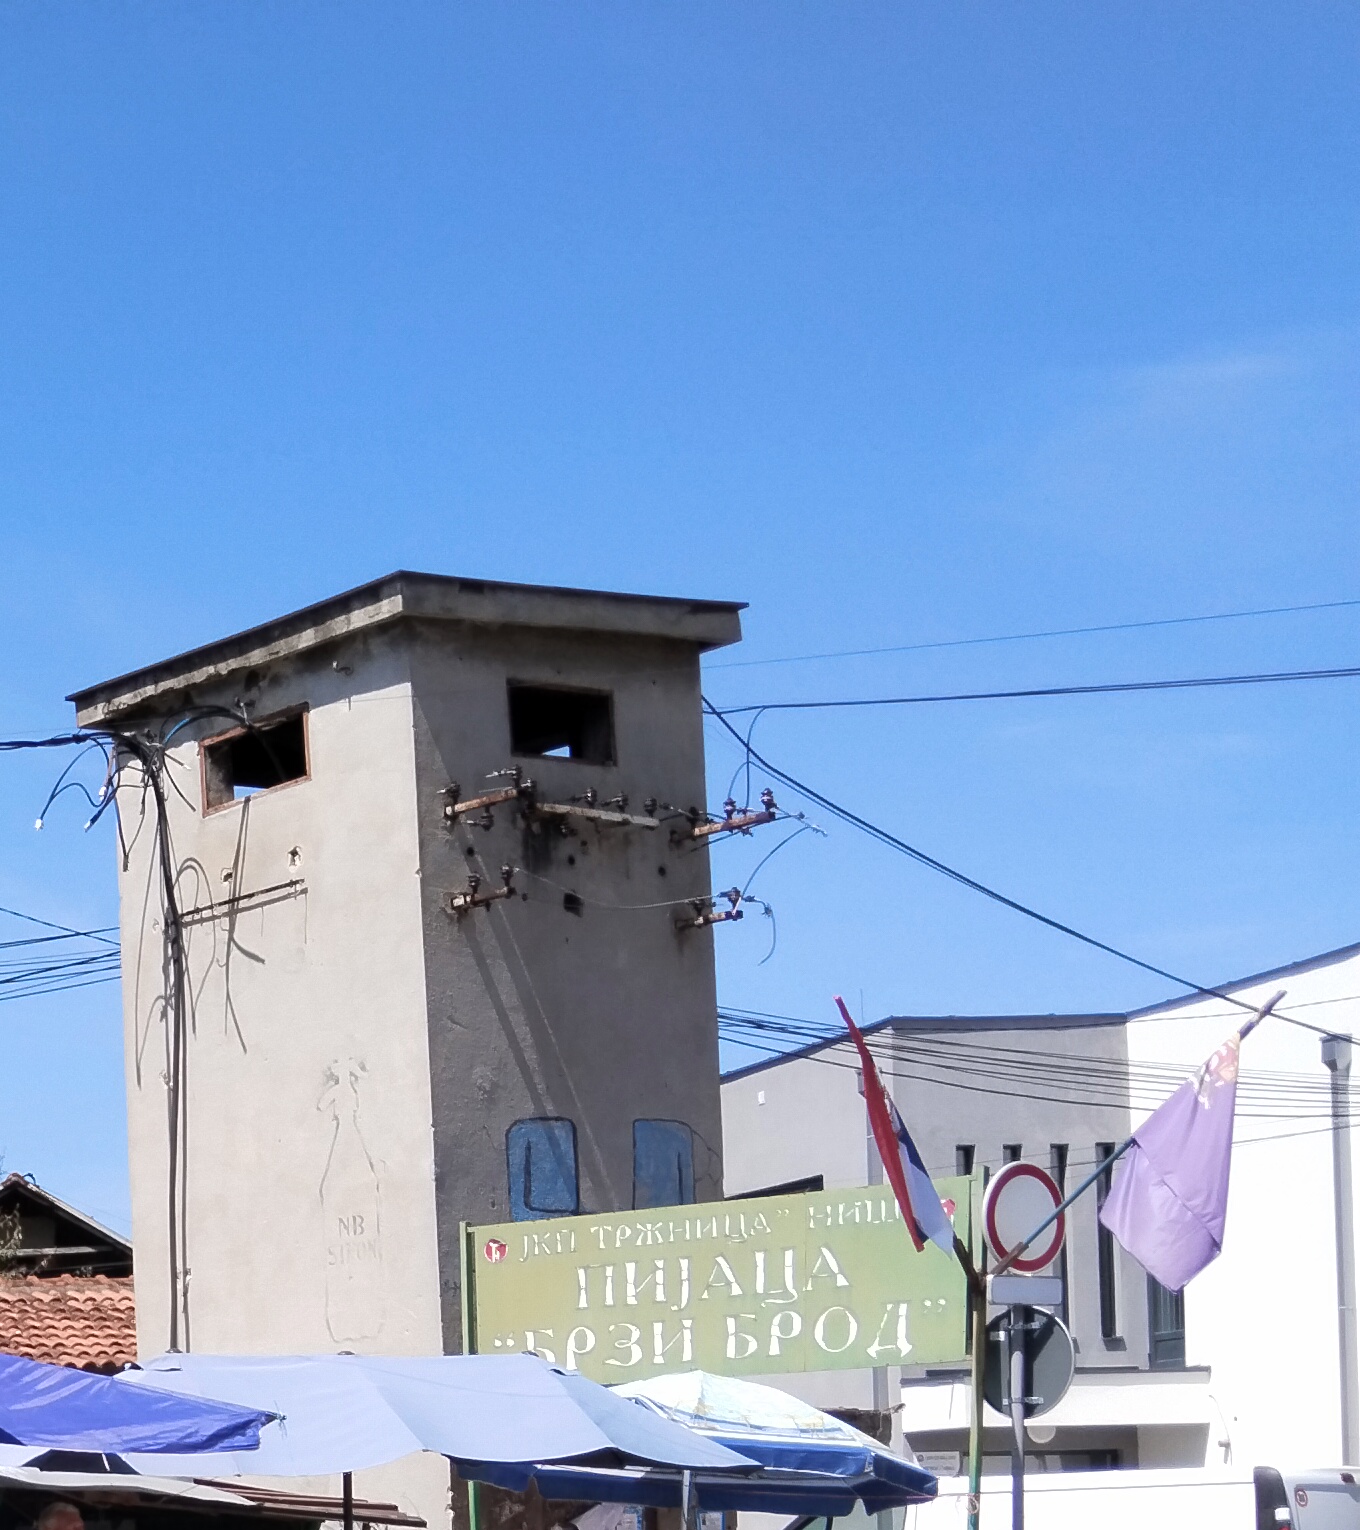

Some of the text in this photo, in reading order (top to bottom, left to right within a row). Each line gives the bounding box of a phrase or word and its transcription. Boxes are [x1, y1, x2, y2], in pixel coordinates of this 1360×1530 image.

[519, 1228, 577, 1262] ЈКП
[808, 1198, 901, 1229] НИШ
[576, 1245, 851, 1312] ПИЈАЦА
